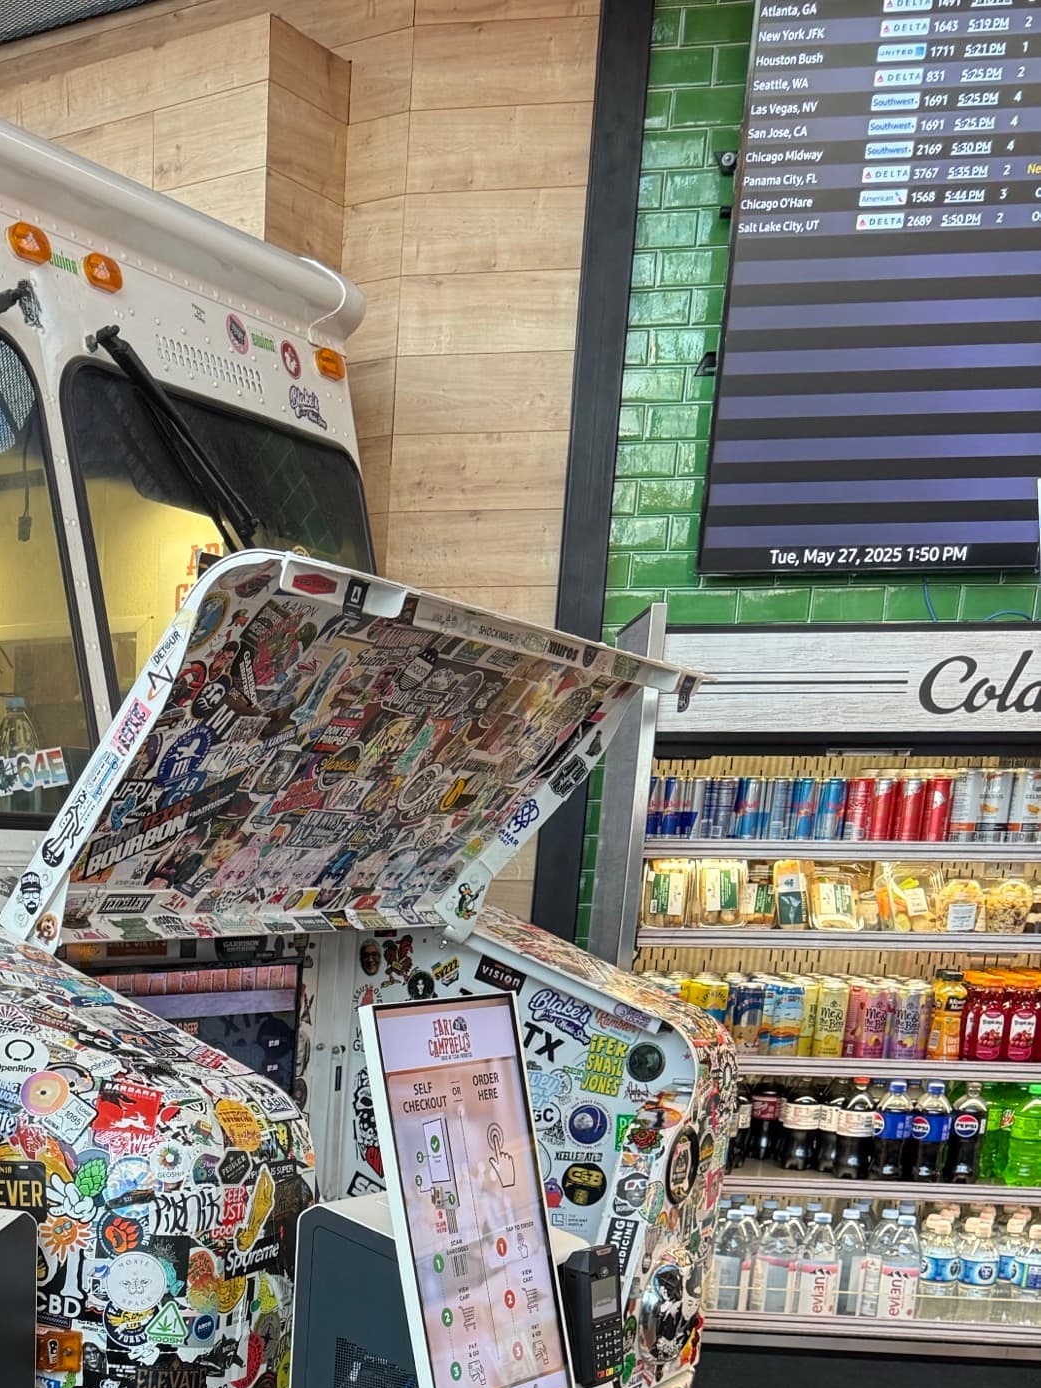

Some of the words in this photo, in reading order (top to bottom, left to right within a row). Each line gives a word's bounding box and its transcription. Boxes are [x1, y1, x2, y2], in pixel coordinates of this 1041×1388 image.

[761, 4, 800, 17] Atlanta,
[802, 4, 817, 15] GA
[759, 32, 780, 42] New
[783, 29, 805, 40] York
[806, 28, 824, 39] JFK
[894, 22, 927, 32] DELTA
[934, 20, 958, 32] 1643
[968, 19, 993, 30] 5:19
[994, 18, 1010, 29] PM
[756, 54, 796, 66] Houston
[799, 53, 823, 64] Bush
[931, 45, 954, 57] 1711
[965, 44, 989, 55] 5:21
[990, 43, 1006, 54] PM
[754, 79, 790, 91] Seattle,
[793, 78, 808, 88] WA
[926, 71, 945, 82] 831
[961, 69, 986, 80] 5:25
[986, 68, 1003, 78] PM
[751, 104, 767, 115] Las
[770, 103, 800, 115] Vegas,
[803, 102, 817, 112] NV
[873, 97, 915, 107] Southwest
[924, 95, 948, 106] 1691
[748, 128, 766, 139] San
[768, 128, 791, 139] Jose,
[794, 126, 807, 137] CA
[921, 120, 944, 131] 1691
[746, 152, 783, 163] Chicago
[785, 150, 822, 162] Midway
[917, 144, 942, 155] 2169
[951, 143, 975, 153] 5:30
[976, 141, 992, 152] PM
[743, 176, 781, 186] Panama
[783, 174, 804, 186] City,
[806, 173, 817, 184] FL
[875, 170, 909, 178] DELTA
[913, 168, 939, 179] 3767
[741, 200, 778, 211] Chicago
[780, 198, 812, 208] O'Hare
[911, 192, 935, 202] 1568
[738, 223, 756, 233] Salt
[759, 222, 781, 233] Lake
[783, 221, 804, 233] City,
[806, 220, 819, 231] UT
[908, 215, 932, 226] 2689
[941, 215, 966, 225] 5:50
[966, 213, 982, 224] PM
[770, 550, 800, 566] Tue,
[803, 549, 835, 566] May
[838, 548, 861, 565] 27,
[864, 548, 902, 562] 2025
[907, 547, 939, 562] 1:50
[943, 546, 968, 561] PM
[85, 812, 189, 877] BOURBON
[533, 990, 590, 1023] Blake's
[433, 1018, 452, 1036] EARL
[79, 1032, 112, 1048] FC
[428, 1033, 470, 1057] CAMPBELL'S
[524, 1022, 565, 1062] TX
[413, 1082, 433, 1095] SELF
[472, 1072, 499, 1086] ORDER
[581, 1076, 620, 1097] JONES
[105, 1082, 158, 1098] BARBARA
[452, 1086, 461, 1096] OR
[478, 1087, 499, 1101] HERE
[403, 1096, 447, 1114] CHECKOUT
[64, 1109, 82, 1126] 1095
[955, 1121, 977, 1129] PEPSI
[224, 1187, 245, 1202] KEEP
[812, 1273, 826, 1314] evian
[888, 1278, 902, 1317] evian
[37, 1292, 81, 1318] CBD
[148, 1335, 184, 1344] KOOSH
